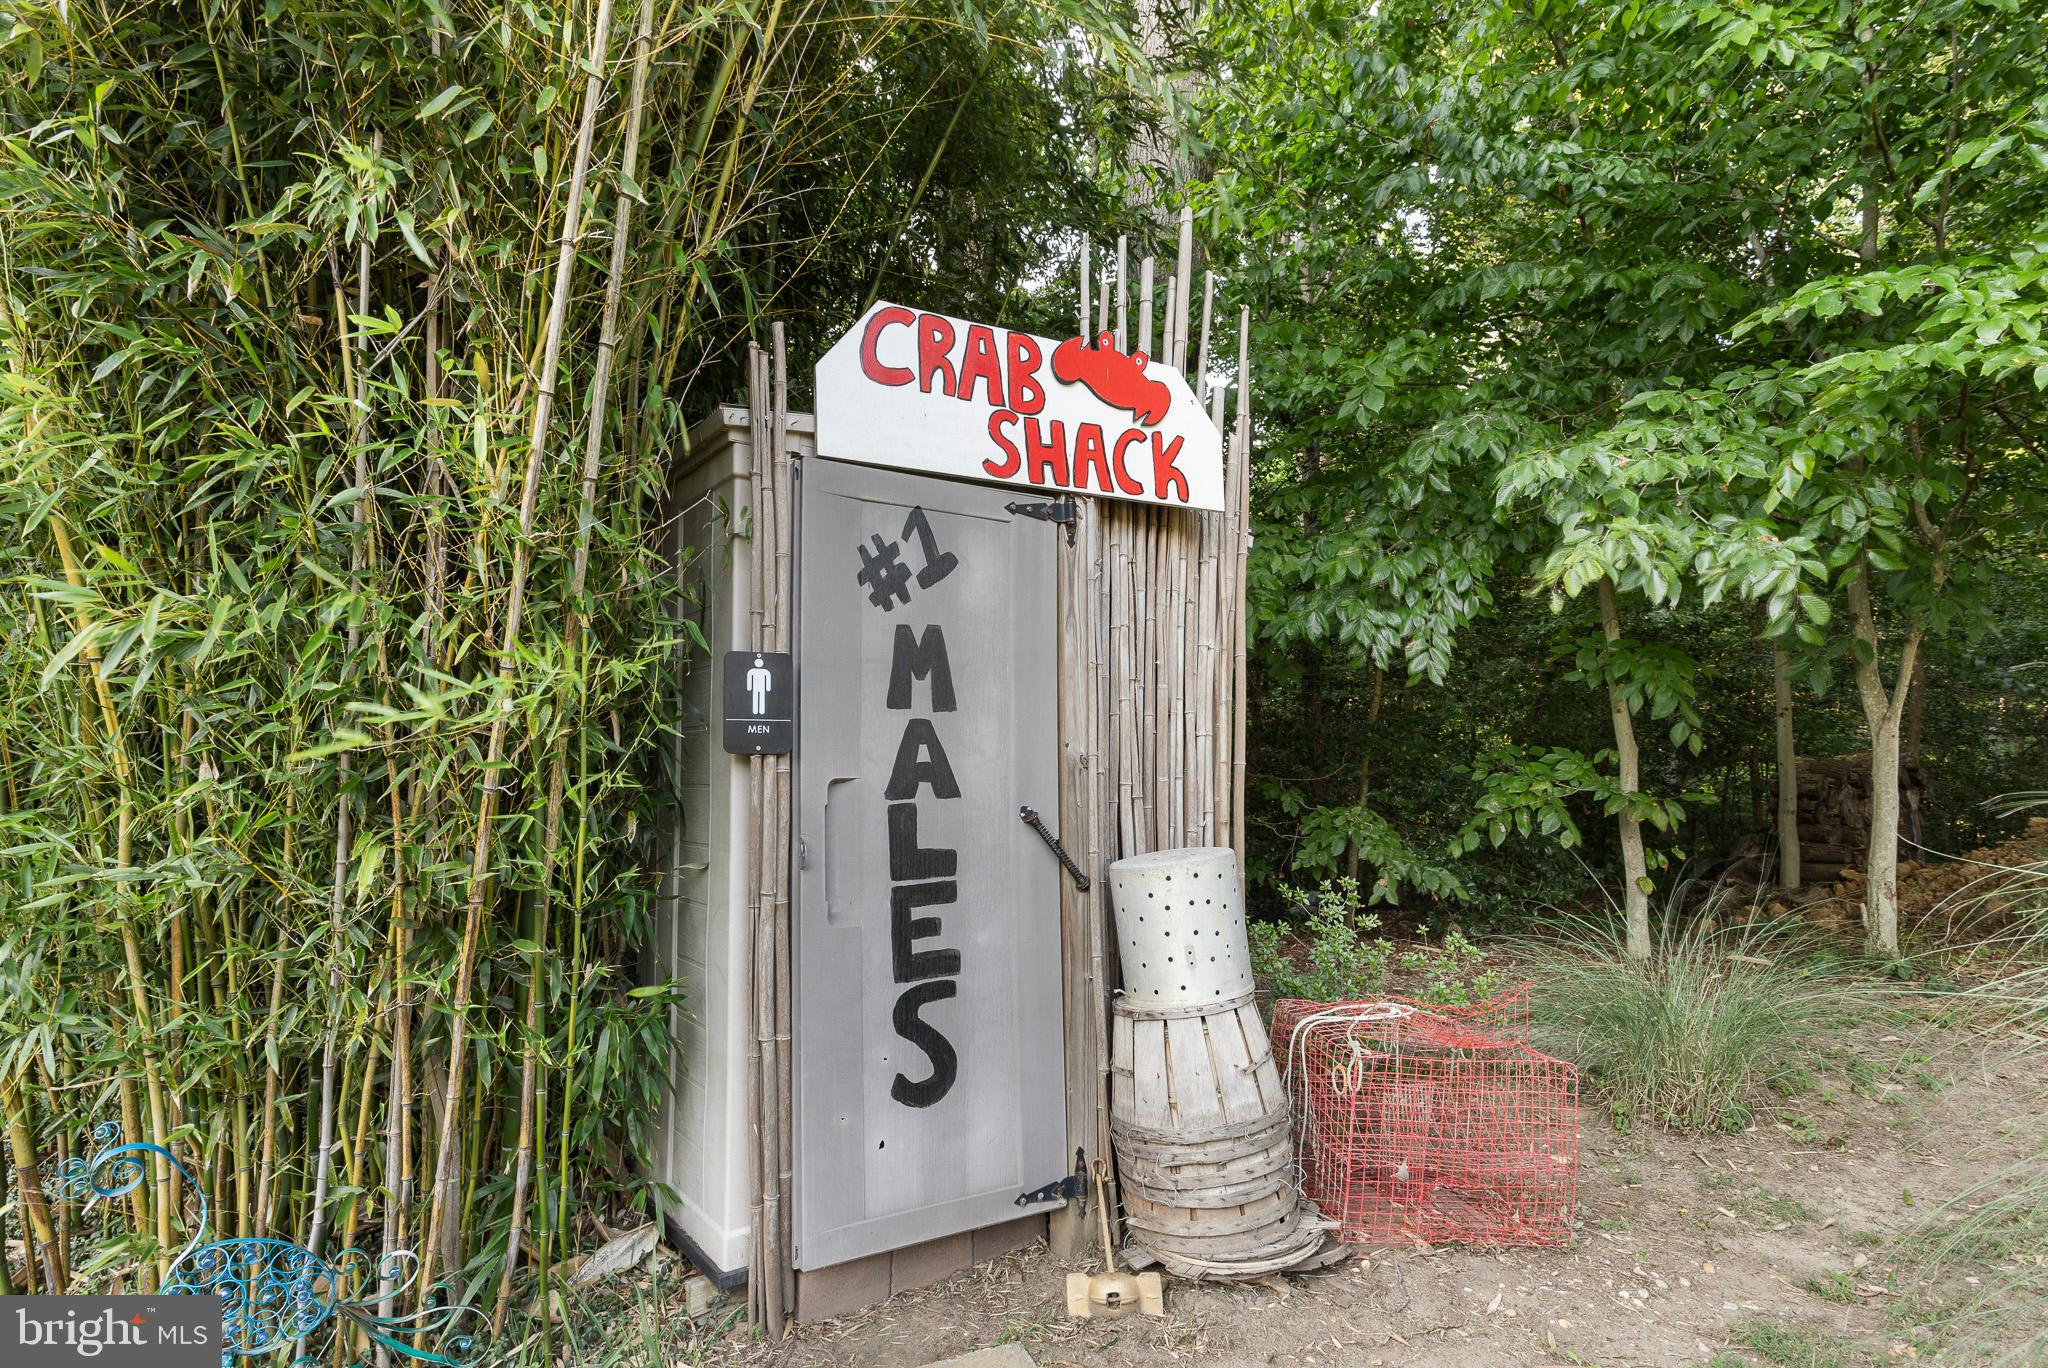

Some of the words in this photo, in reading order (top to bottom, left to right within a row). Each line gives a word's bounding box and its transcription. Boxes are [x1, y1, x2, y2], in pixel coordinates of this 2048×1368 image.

[859, 306, 1046, 416] CRAB
[982, 409, 1190, 503] SHACK
[857, 505, 959, 612] #1
[747, 725, 770, 733] MEN
[884, 624, 962, 1108] MALES
